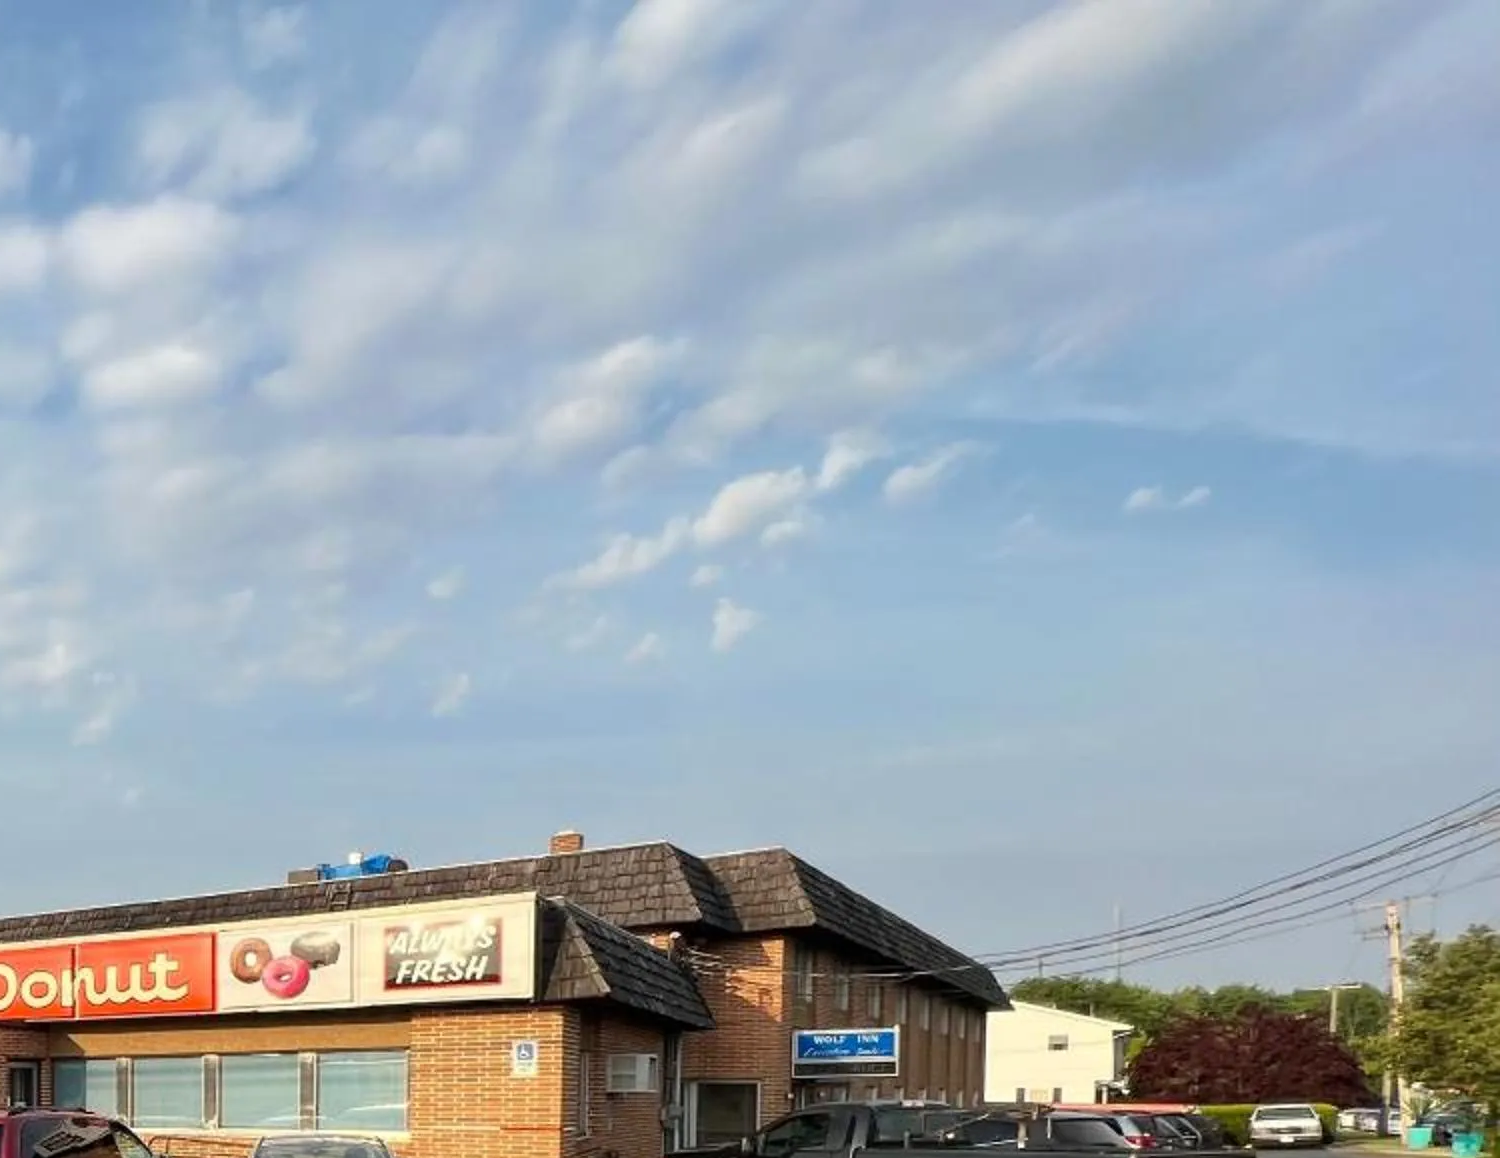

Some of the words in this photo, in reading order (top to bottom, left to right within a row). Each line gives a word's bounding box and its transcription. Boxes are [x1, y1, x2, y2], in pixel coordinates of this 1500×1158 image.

[388, 925, 497, 955] ALWS
[396, 954, 489, 984] FRESH
[813, 1035, 847, 1044] WOLF
[857, 1034, 879, 1043] INN
